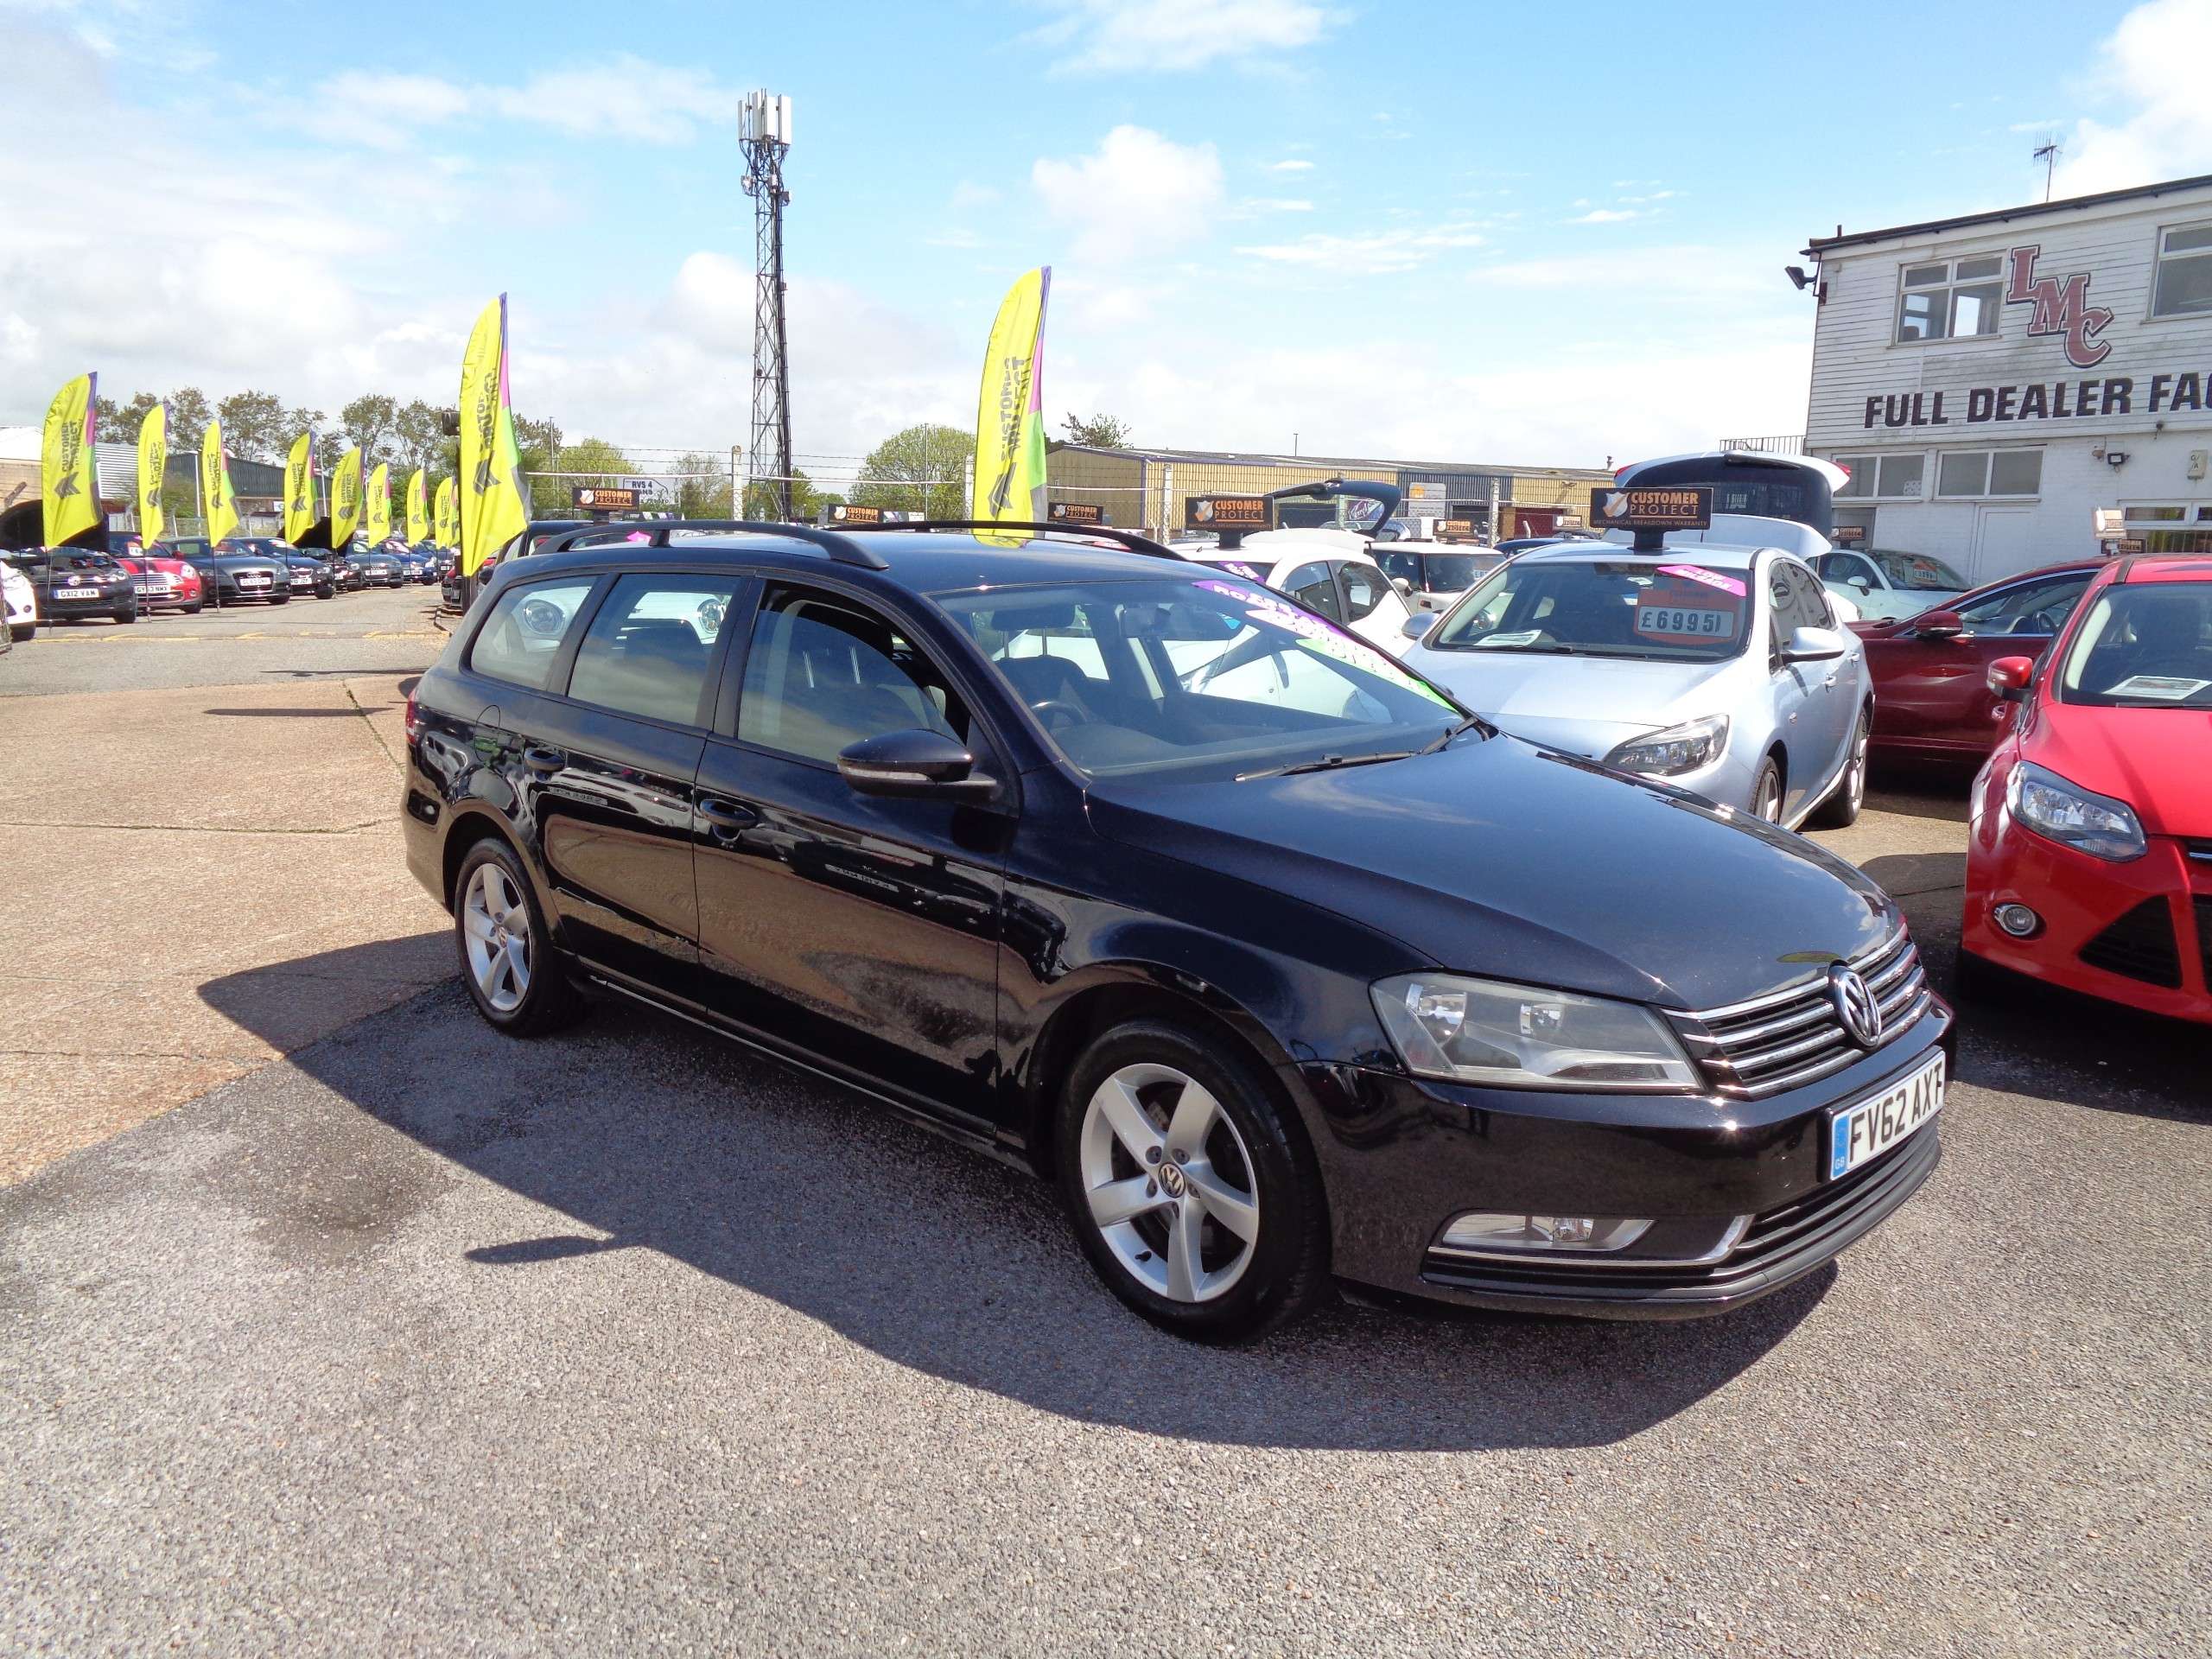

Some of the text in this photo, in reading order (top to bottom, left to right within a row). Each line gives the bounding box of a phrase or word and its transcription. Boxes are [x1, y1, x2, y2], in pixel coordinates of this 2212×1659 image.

[2006, 244, 2114, 368] LMC
[1864, 391, 1948, 429] FULL
[1967, 377, 2134, 423] DEALER
[632, 480, 653, 489] RVS 4
[594, 490, 632, 499] CUSTOMER
[1630, 492, 1699, 505] CUSTOMER
[847, 506, 879, 515] CUSTOMER
[1066, 505, 1097, 513] CUSTOMER
[1215, 500, 1263, 511] CUSTOMER
[1630, 504, 1699, 515] PROTECT
[1215, 510, 1263, 519] PROTECT
[1849, 1088, 1907, 1163] FV62
